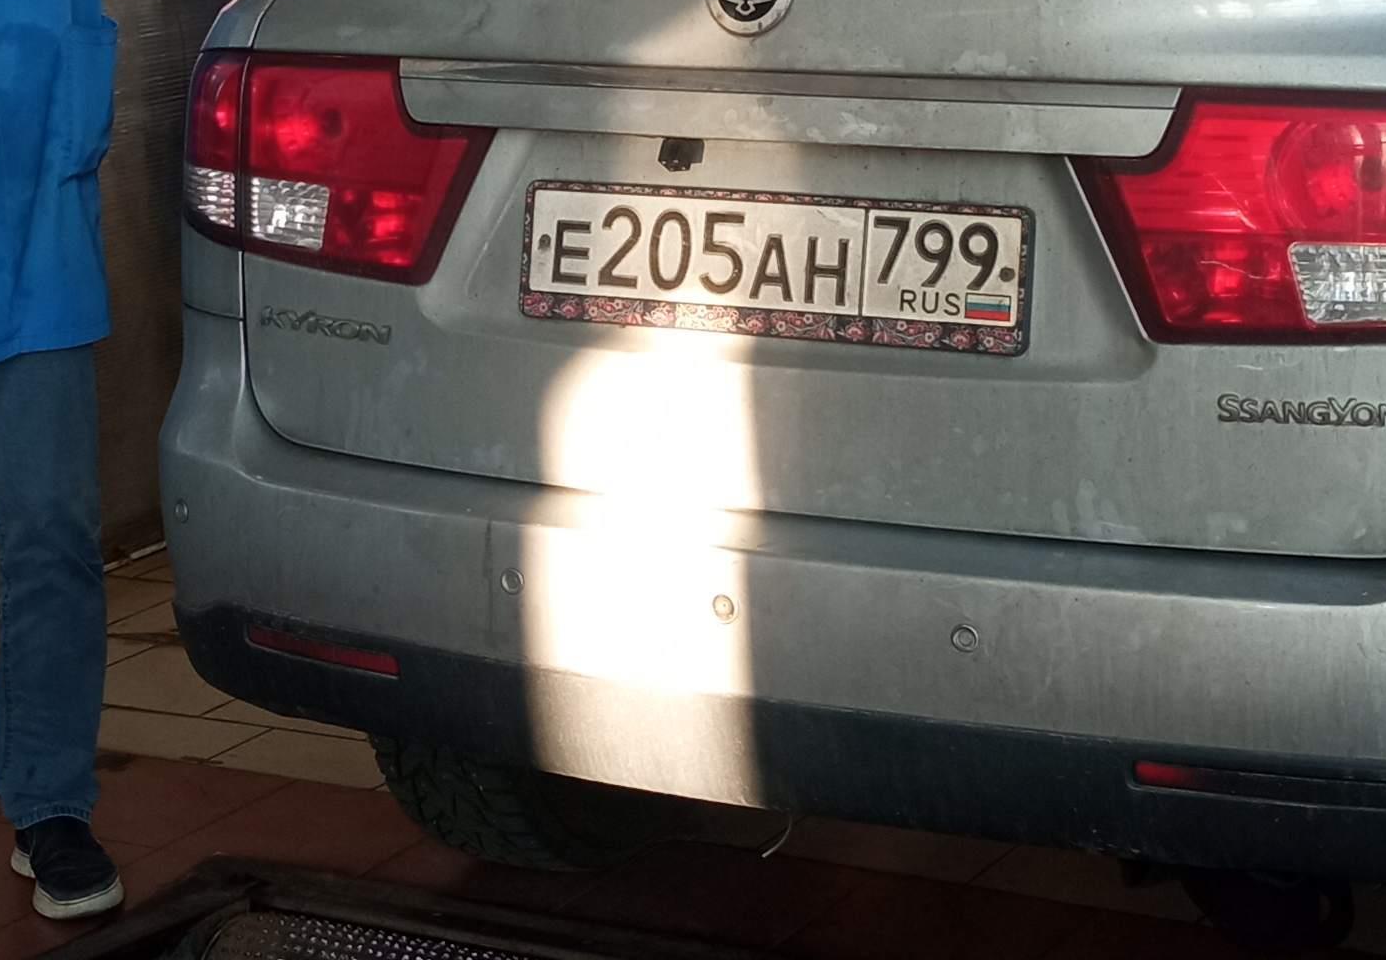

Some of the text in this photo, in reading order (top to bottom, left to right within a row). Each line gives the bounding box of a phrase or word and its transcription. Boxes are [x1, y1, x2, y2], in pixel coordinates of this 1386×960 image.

[873, 215, 999, 291] 799
[899, 290, 961, 316] RUS
[261, 305, 391, 345] KYRON
